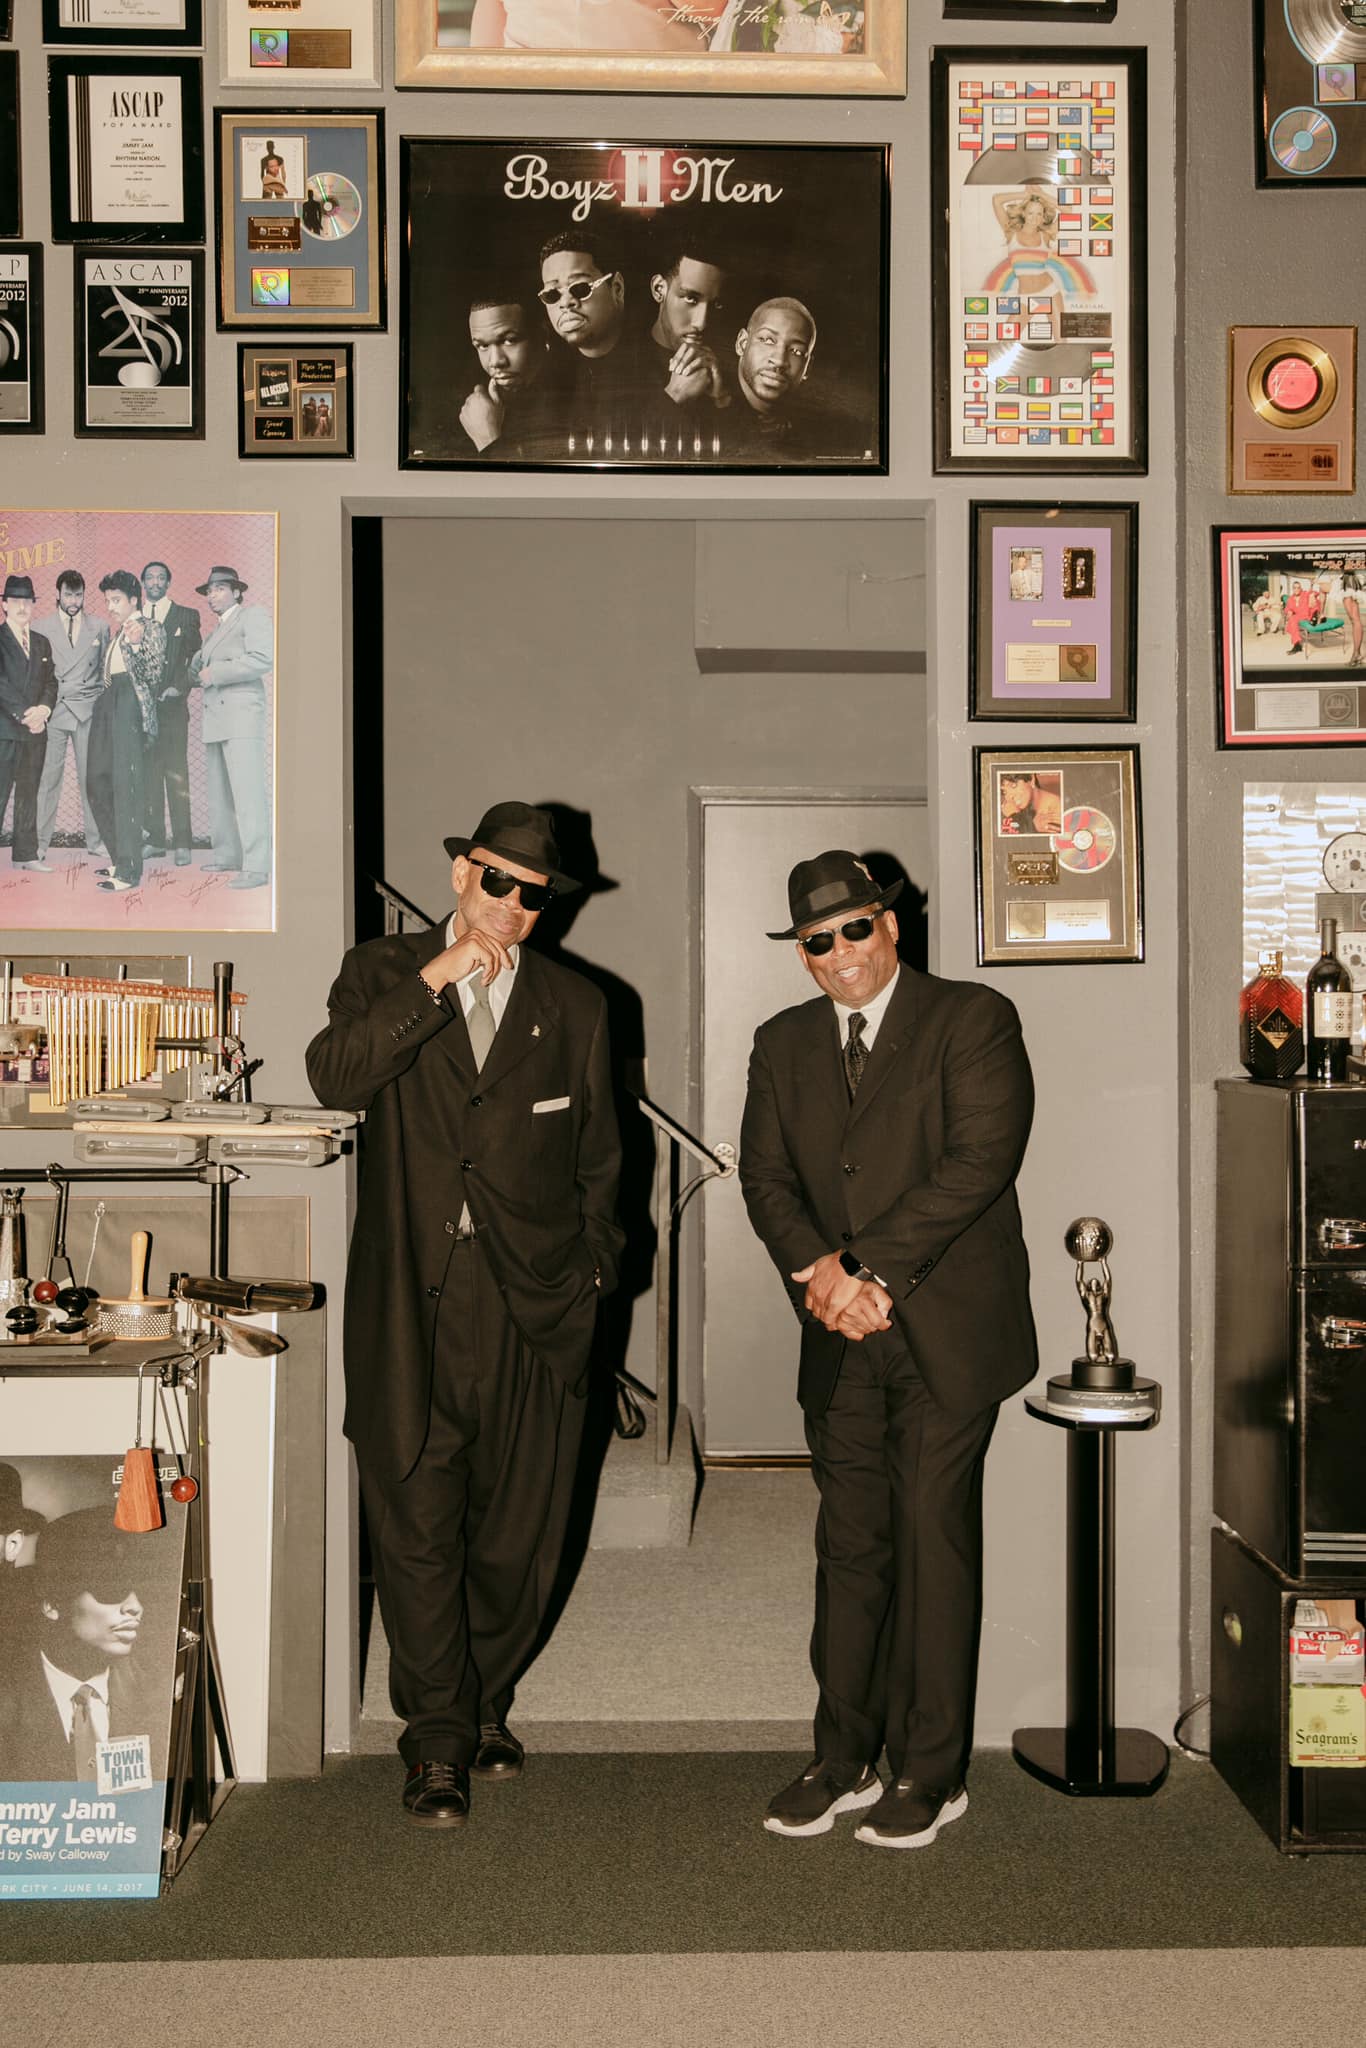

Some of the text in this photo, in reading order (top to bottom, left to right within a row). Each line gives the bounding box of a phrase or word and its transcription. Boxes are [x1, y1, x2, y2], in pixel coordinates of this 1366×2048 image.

[740, 6, 769, 26] the
[110, 91, 163, 117] ASCAP
[504, 150, 784, 222] Boyz II Men
[92, 263, 184, 281] ASCAP
[0, 290, 25, 301] 2012
[162, 295, 188, 306] 2012
[568, 437, 721, 452] EVOLUTION
[1296, 1729, 1358, 1747] Seagram's
[101, 1748, 144, 1773] TOWN
[111, 1763, 147, 1788] HALL
[62, 1798, 116, 1820] Jam
[65, 1821, 137, 1845] Lewis
[8, 1849, 22, 1863] by
[25, 1848, 55, 1862] Sway
[58, 1849, 110, 1861] Calloway
[21, 1884, 49, 1892] CITY
[62, 1883, 92, 1892] JUNE
[116, 1883, 144, 1892] 2017
